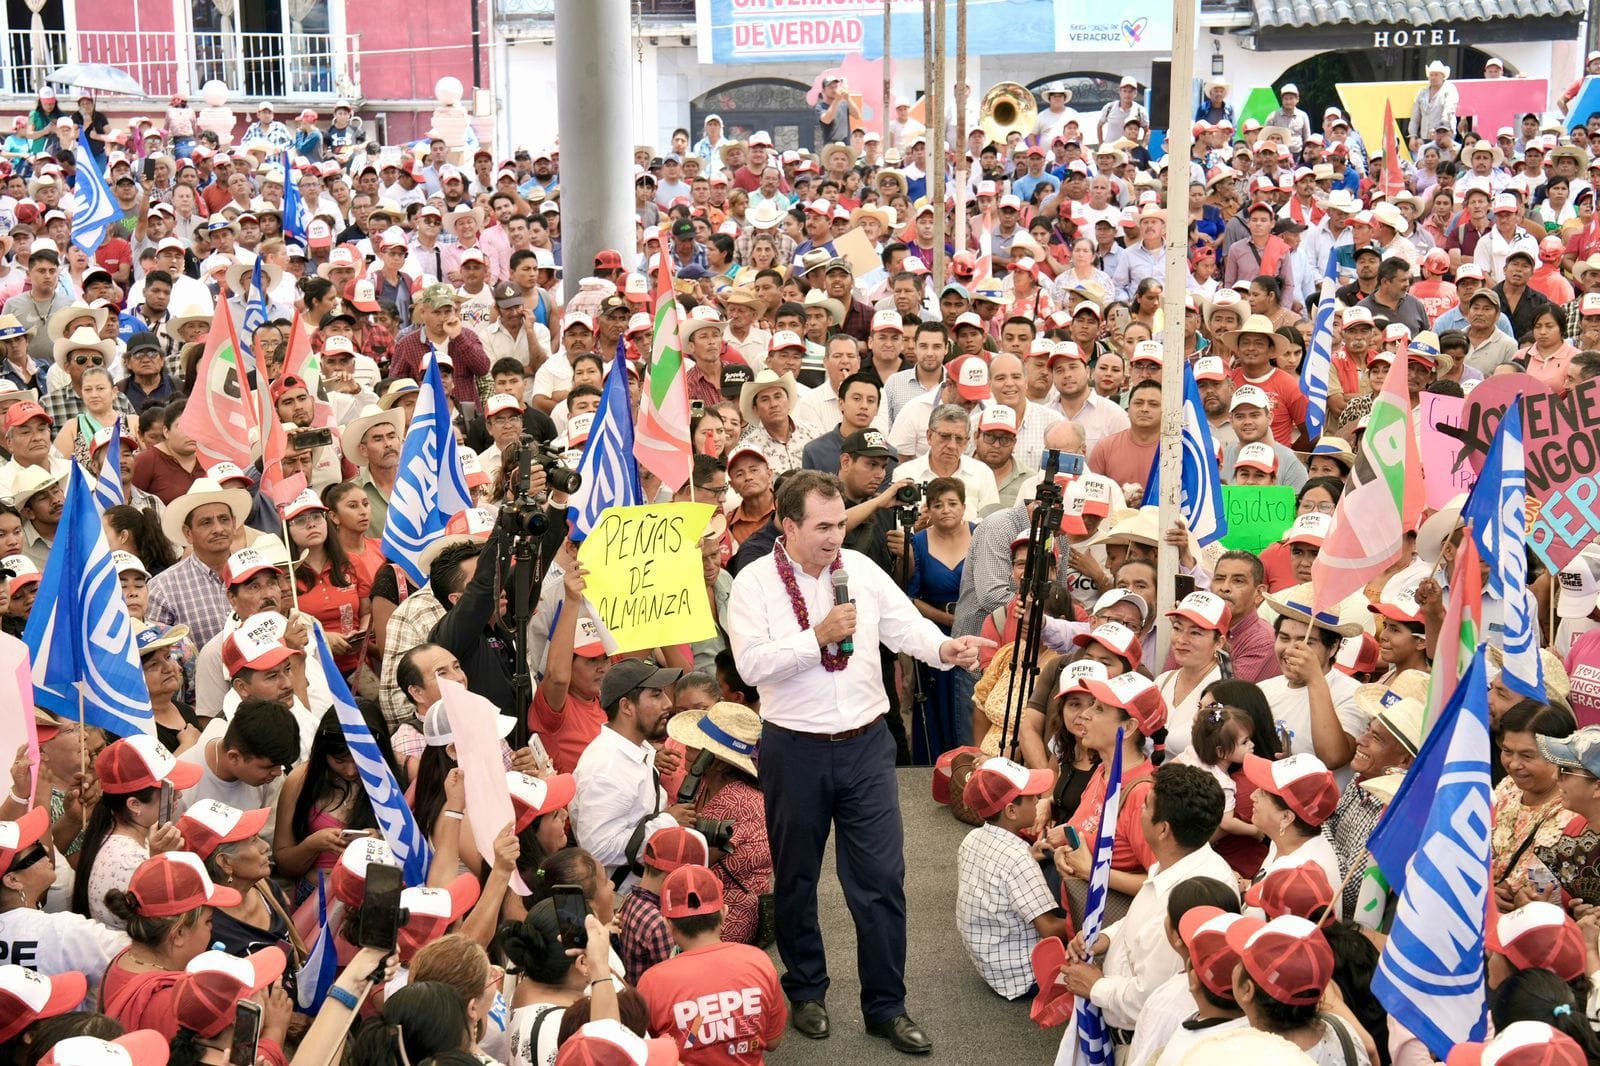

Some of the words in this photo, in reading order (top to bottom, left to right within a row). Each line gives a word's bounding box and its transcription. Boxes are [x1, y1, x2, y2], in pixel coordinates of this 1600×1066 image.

[735, 22, 765, 46] DE
[770, 20, 863, 45] VERDAD
[1069, 33, 1121, 41] VERACRUZ
[1373, 29, 1460, 48] HOTEL
[1085, 481, 1104, 489] PEPE
[1228, 490, 1286, 526] Isidro
[1526, 471, 1600, 577] PEP
[600, 513, 684, 566] PEÑAS
[630, 559, 654, 595] DE
[599, 588, 691, 631] ALMANZA
[673, 987, 762, 1030] PEPE
